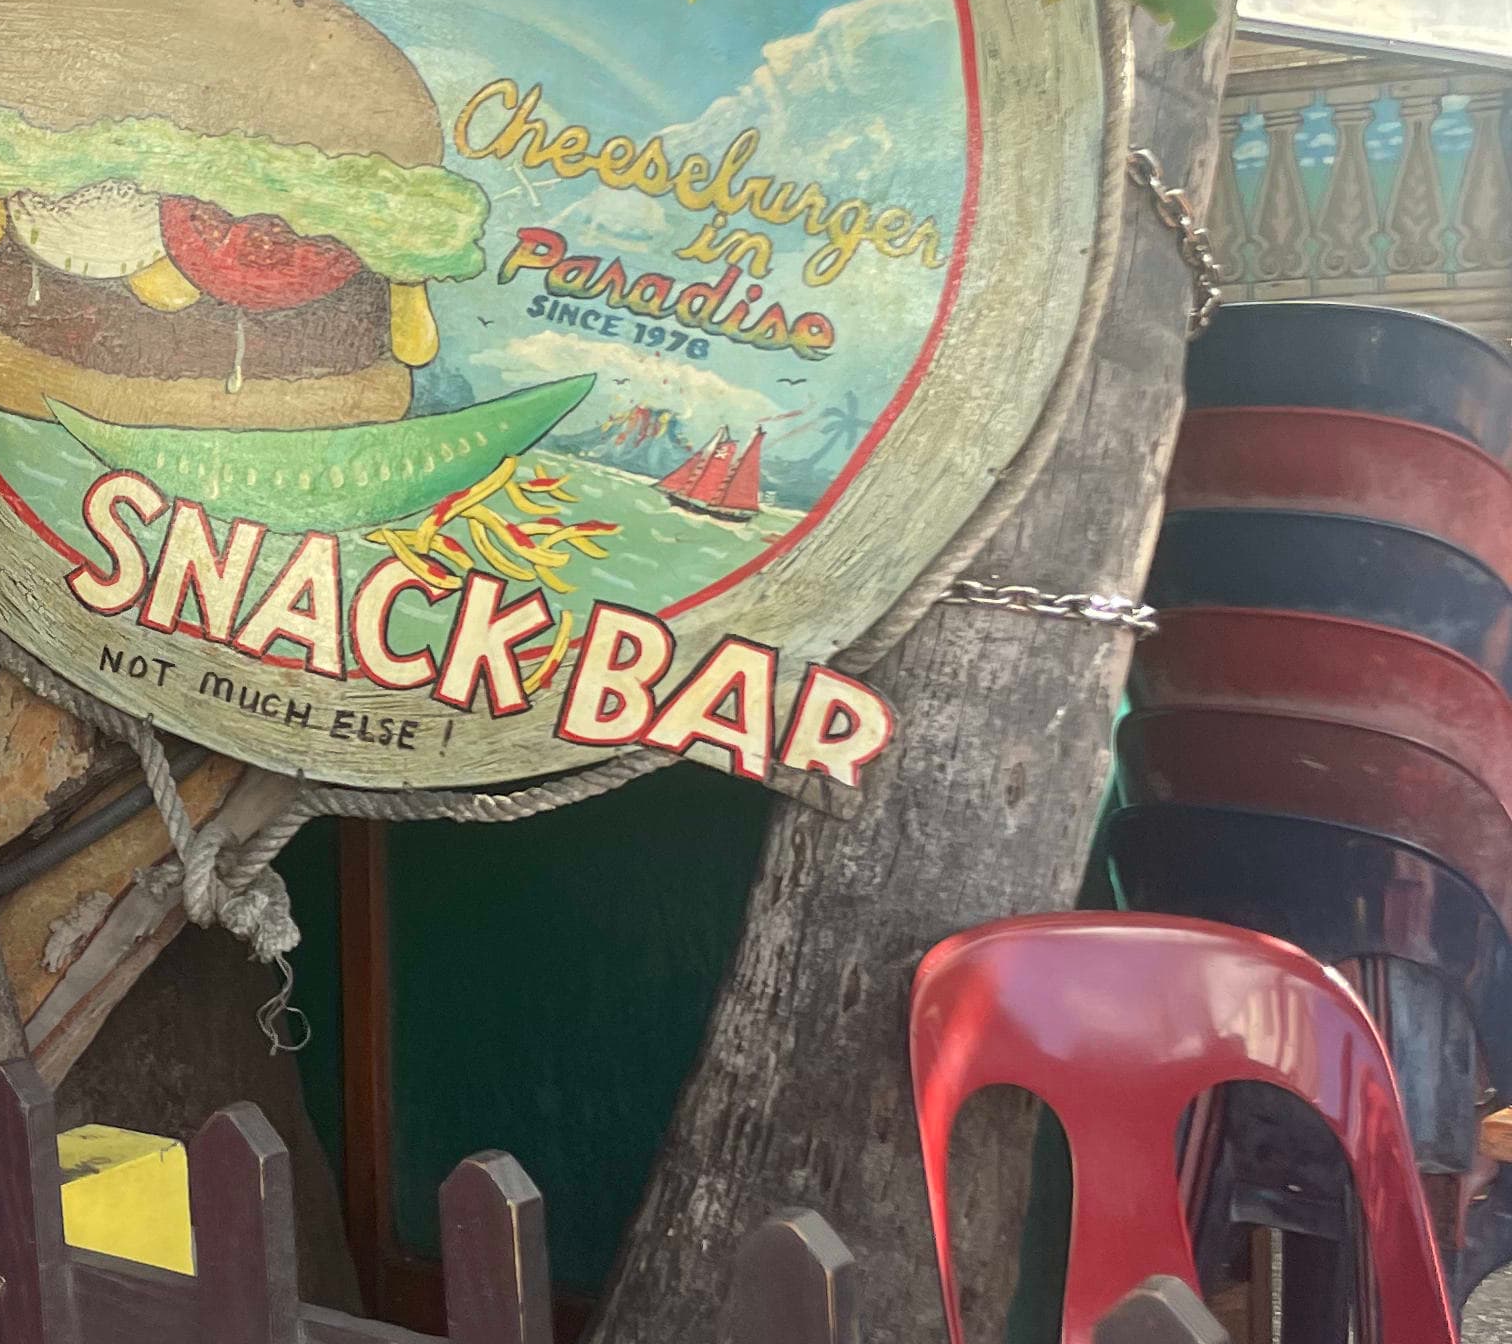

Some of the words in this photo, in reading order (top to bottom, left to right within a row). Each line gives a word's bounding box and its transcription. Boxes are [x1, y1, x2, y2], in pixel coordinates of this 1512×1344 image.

[453, 78, 947, 287] Cheeseburger
[497, 227, 836, 362] Paradise
[674, 213, 774, 280] in
[526, 294, 625, 338] SINCE
[632, 321, 711, 361] 1978
[65, 469, 558, 716] SNACK
[555, 600, 896, 788] BAR
[98, 644, 176, 687] NOT
[329, 709, 419, 751] ELSE
